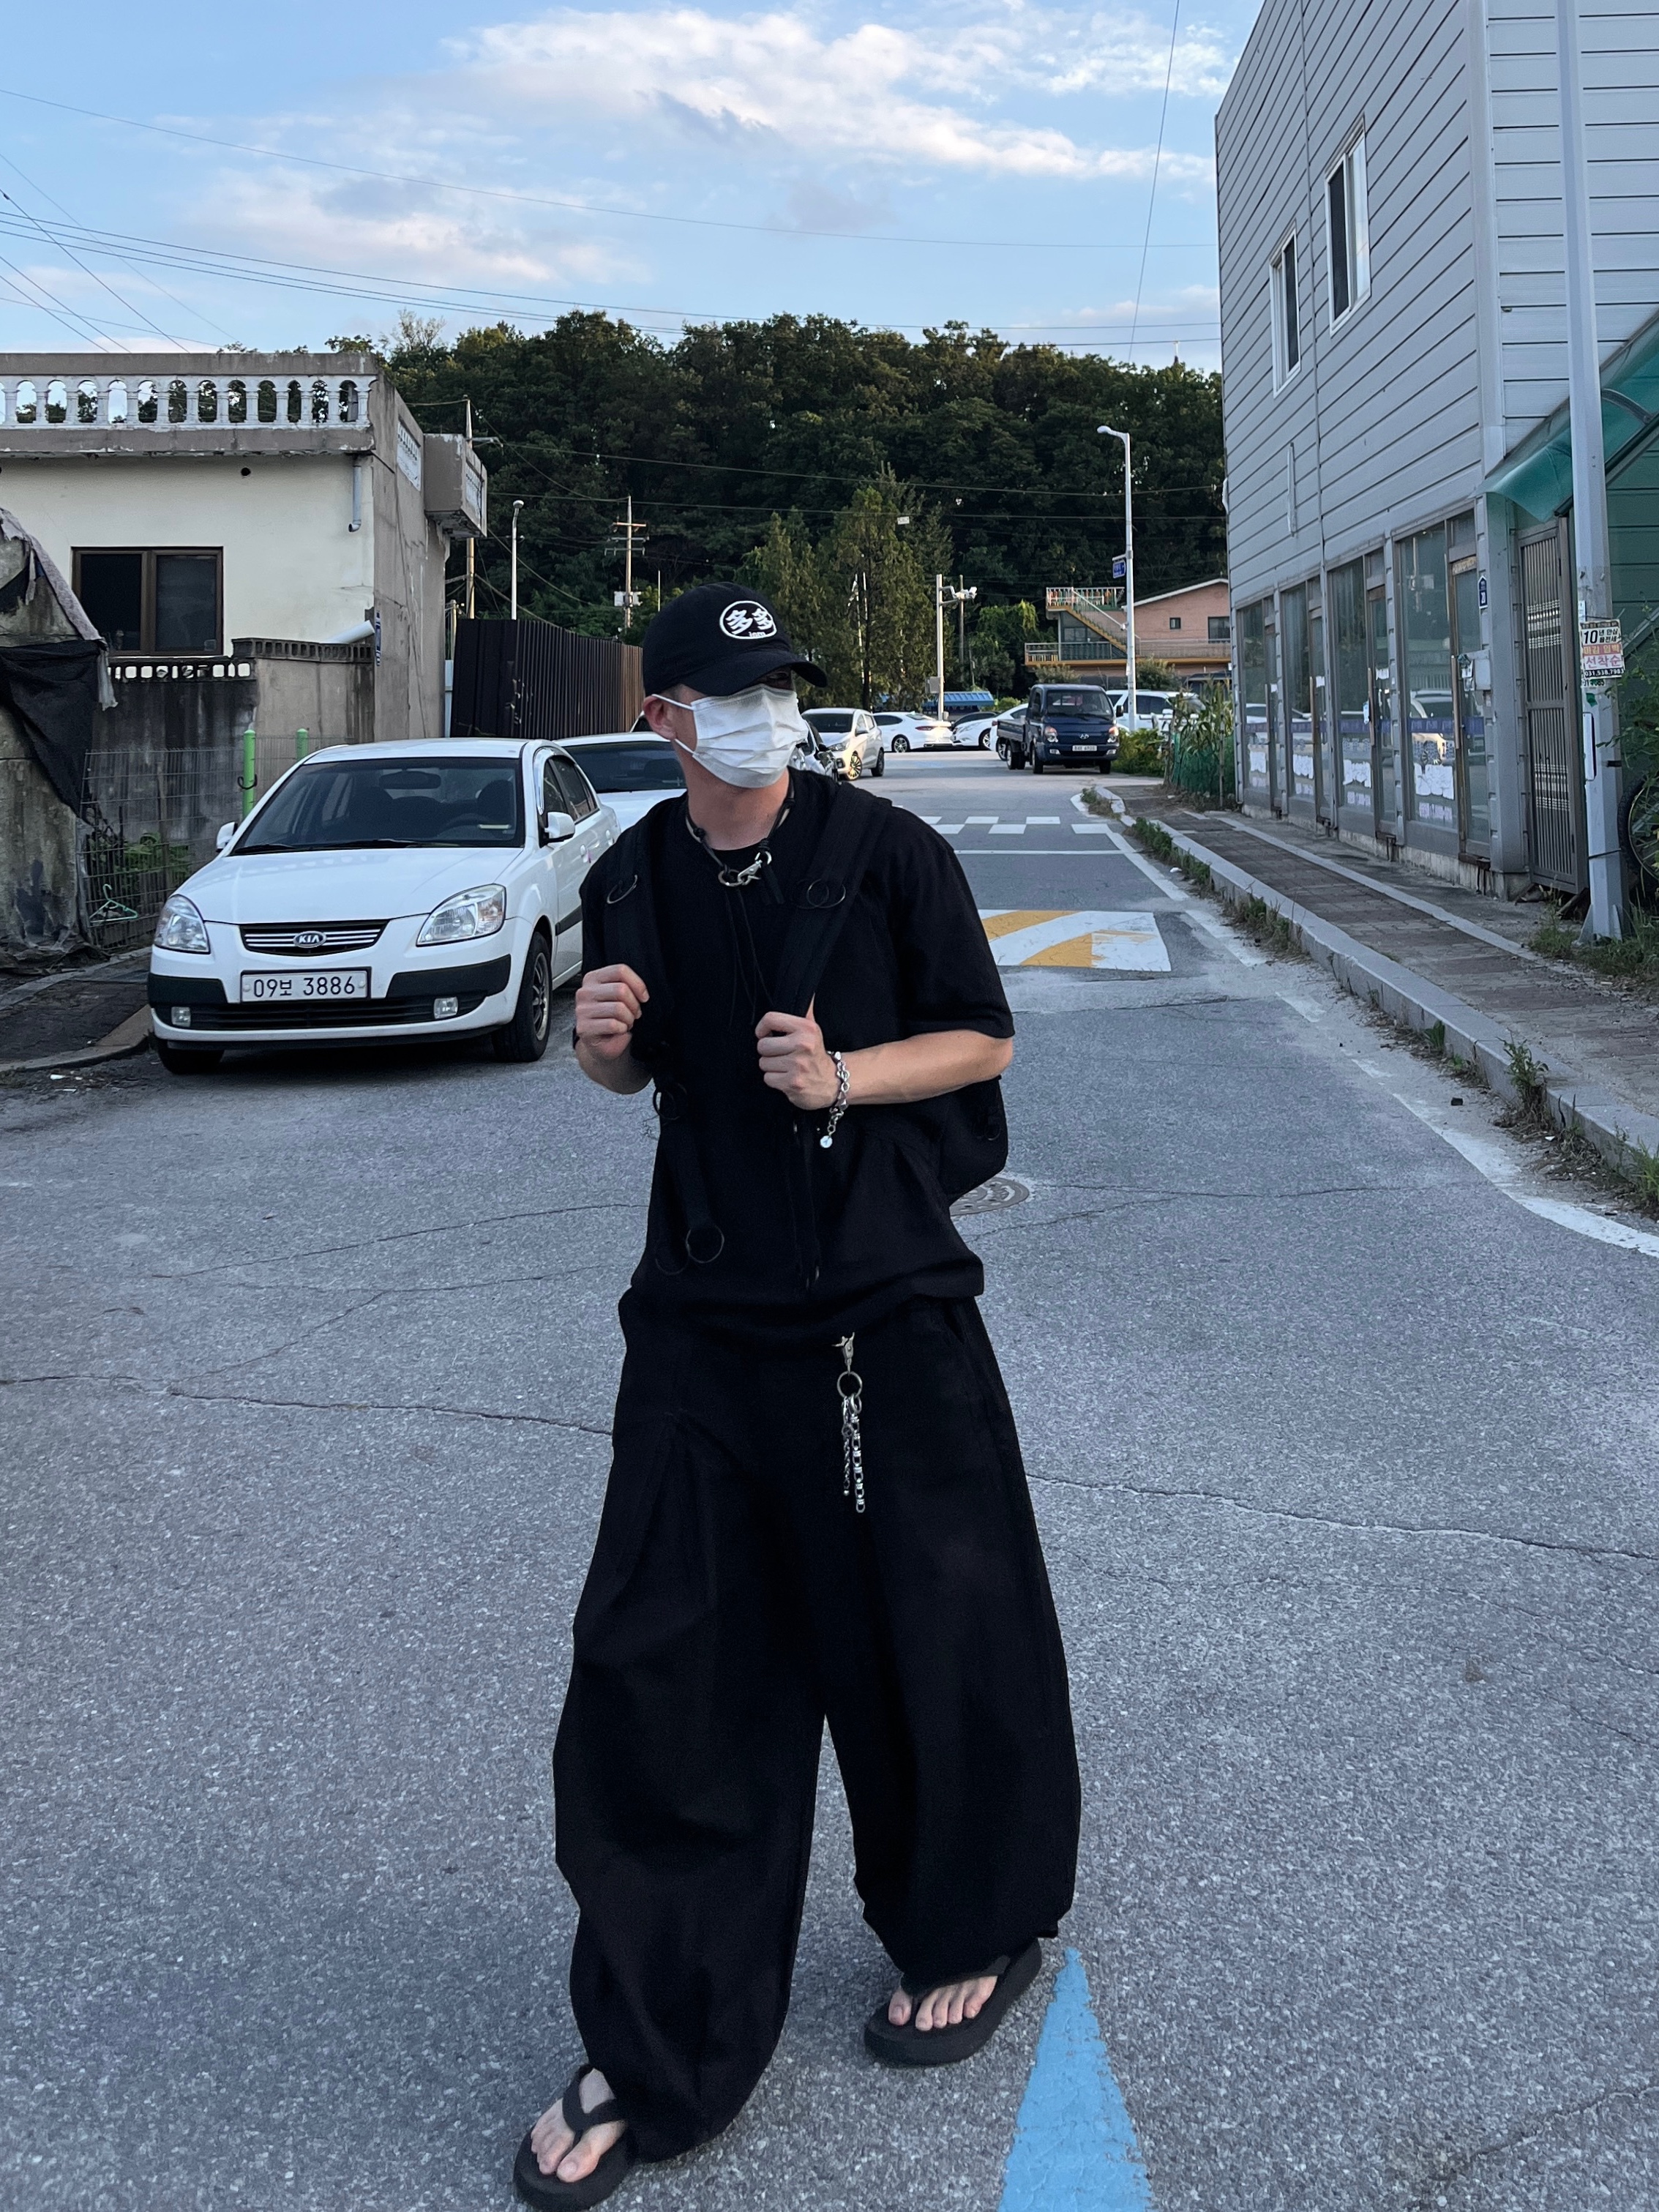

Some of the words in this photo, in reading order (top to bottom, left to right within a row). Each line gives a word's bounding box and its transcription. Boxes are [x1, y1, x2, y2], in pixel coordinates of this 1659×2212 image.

[1586, 654, 1622, 669] 선착순
[299, 934, 320, 944] KIA
[253, 979, 292, 998] 09보
[303, 976, 355, 996] 3886
